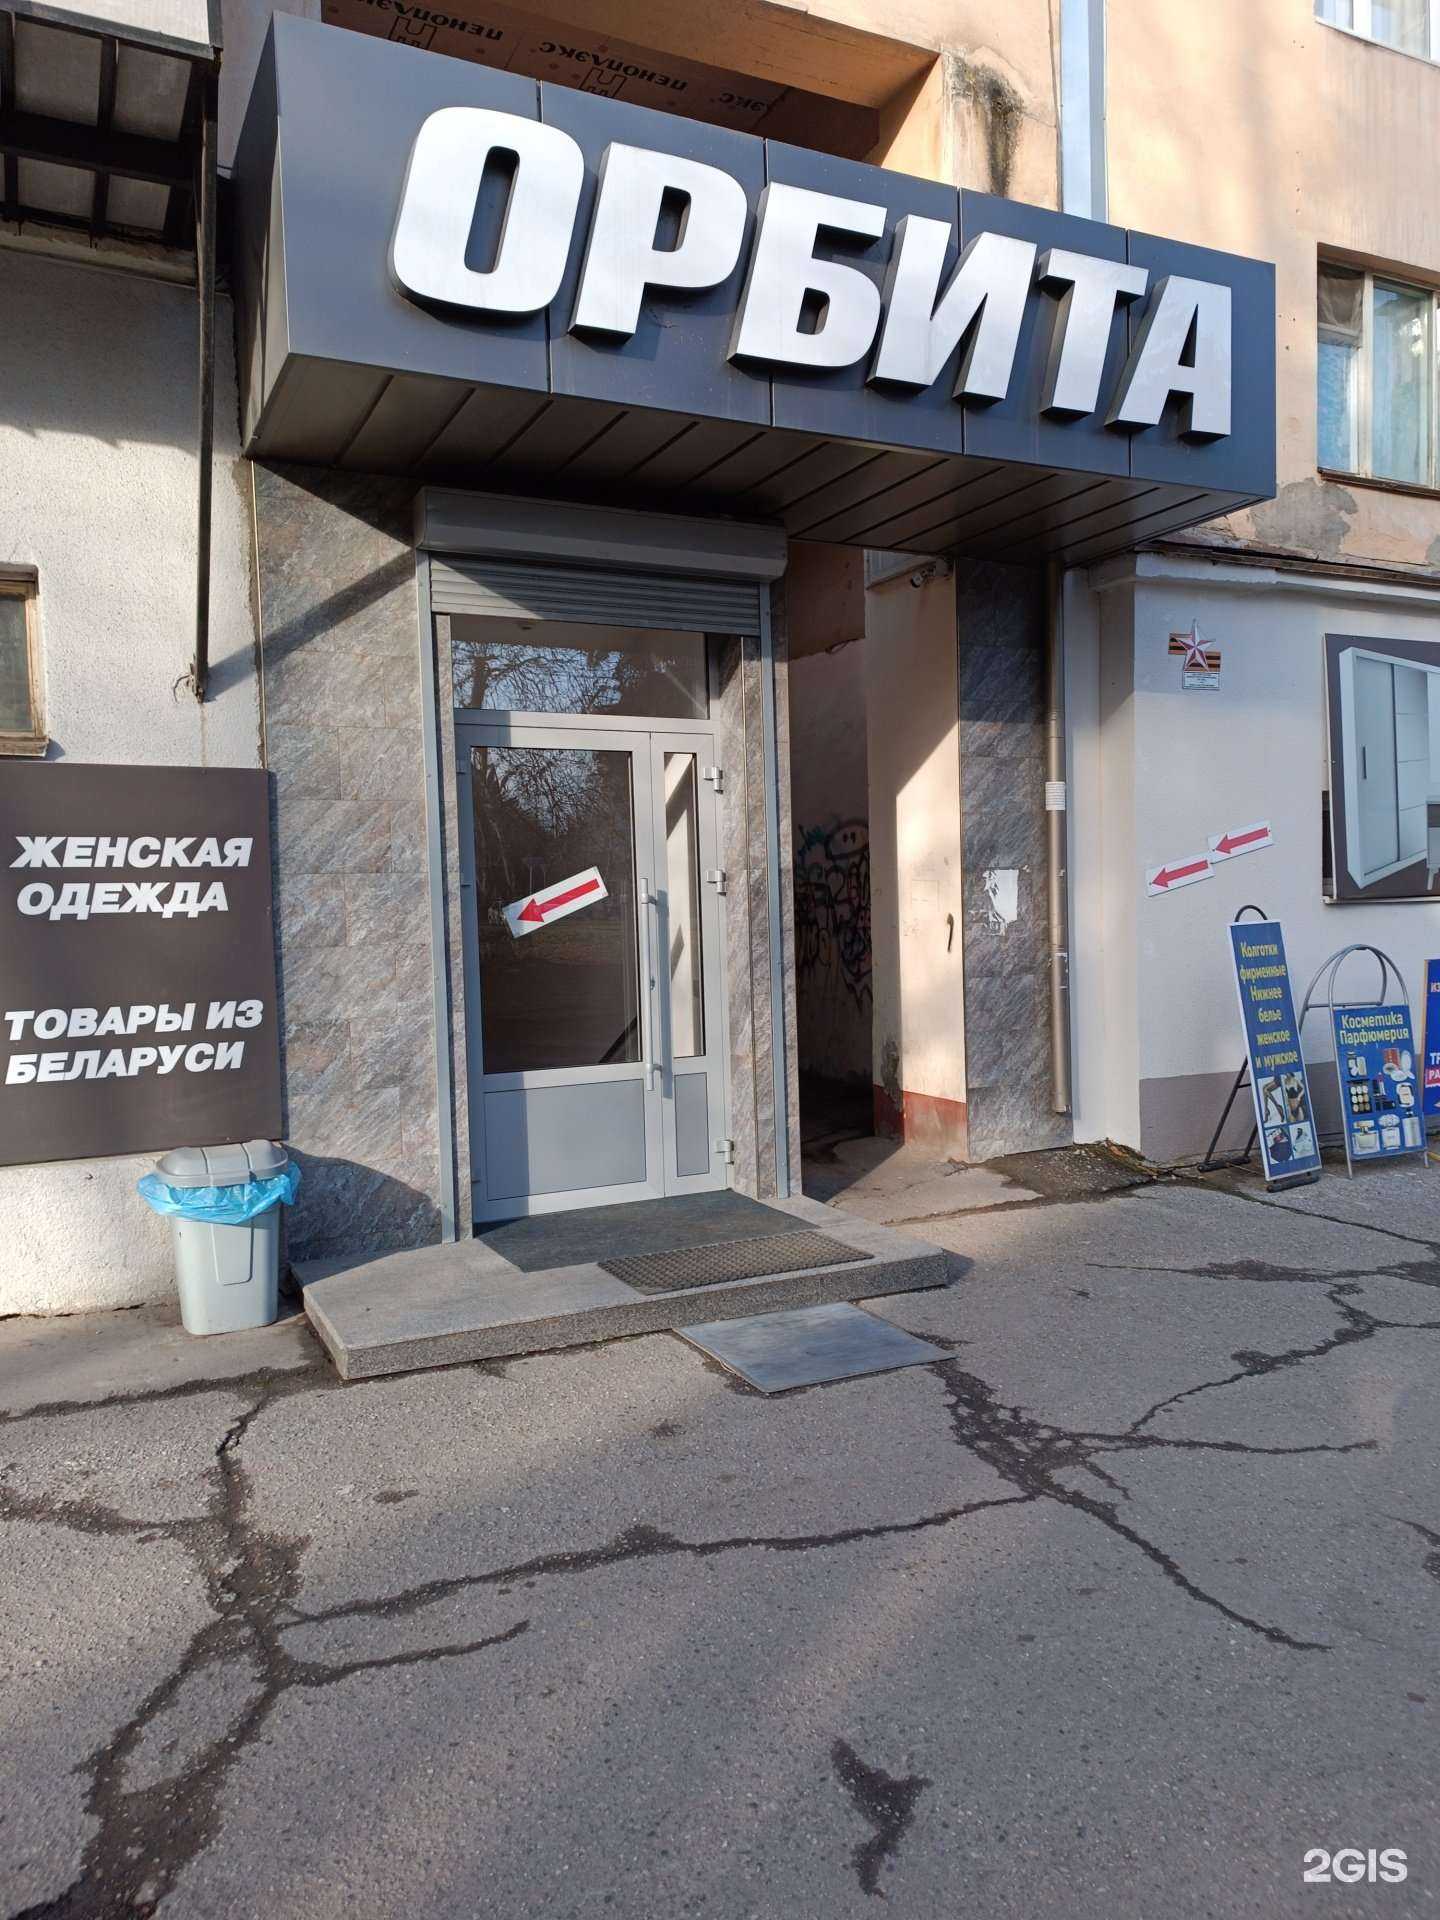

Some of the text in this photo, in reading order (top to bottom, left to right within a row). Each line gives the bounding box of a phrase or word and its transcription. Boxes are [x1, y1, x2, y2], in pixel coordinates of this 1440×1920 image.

[353, 0, 503, 41] ПЕНОПЛЭ
[391, 106, 1233, 442] ОРБИТА
[9, 836, 253, 868] ЖЕНСКАЯ
[16, 881, 229, 921] ОДЕЖДА
[1240, 941, 1278, 958] Колготки
[1240, 964, 1286, 984] фирменные
[1250, 986, 1283, 1001] Нижнее
[4, 999, 264, 1041] ТОВАРЫ ИЗ
[1341, 1011, 1403, 1029] Косметика
[1256, 1030, 1290, 1045] женское
[1340, 1027, 1409, 1046] Парфюмерия
[5, 1041, 245, 1085] БЕЛАРУСИ
